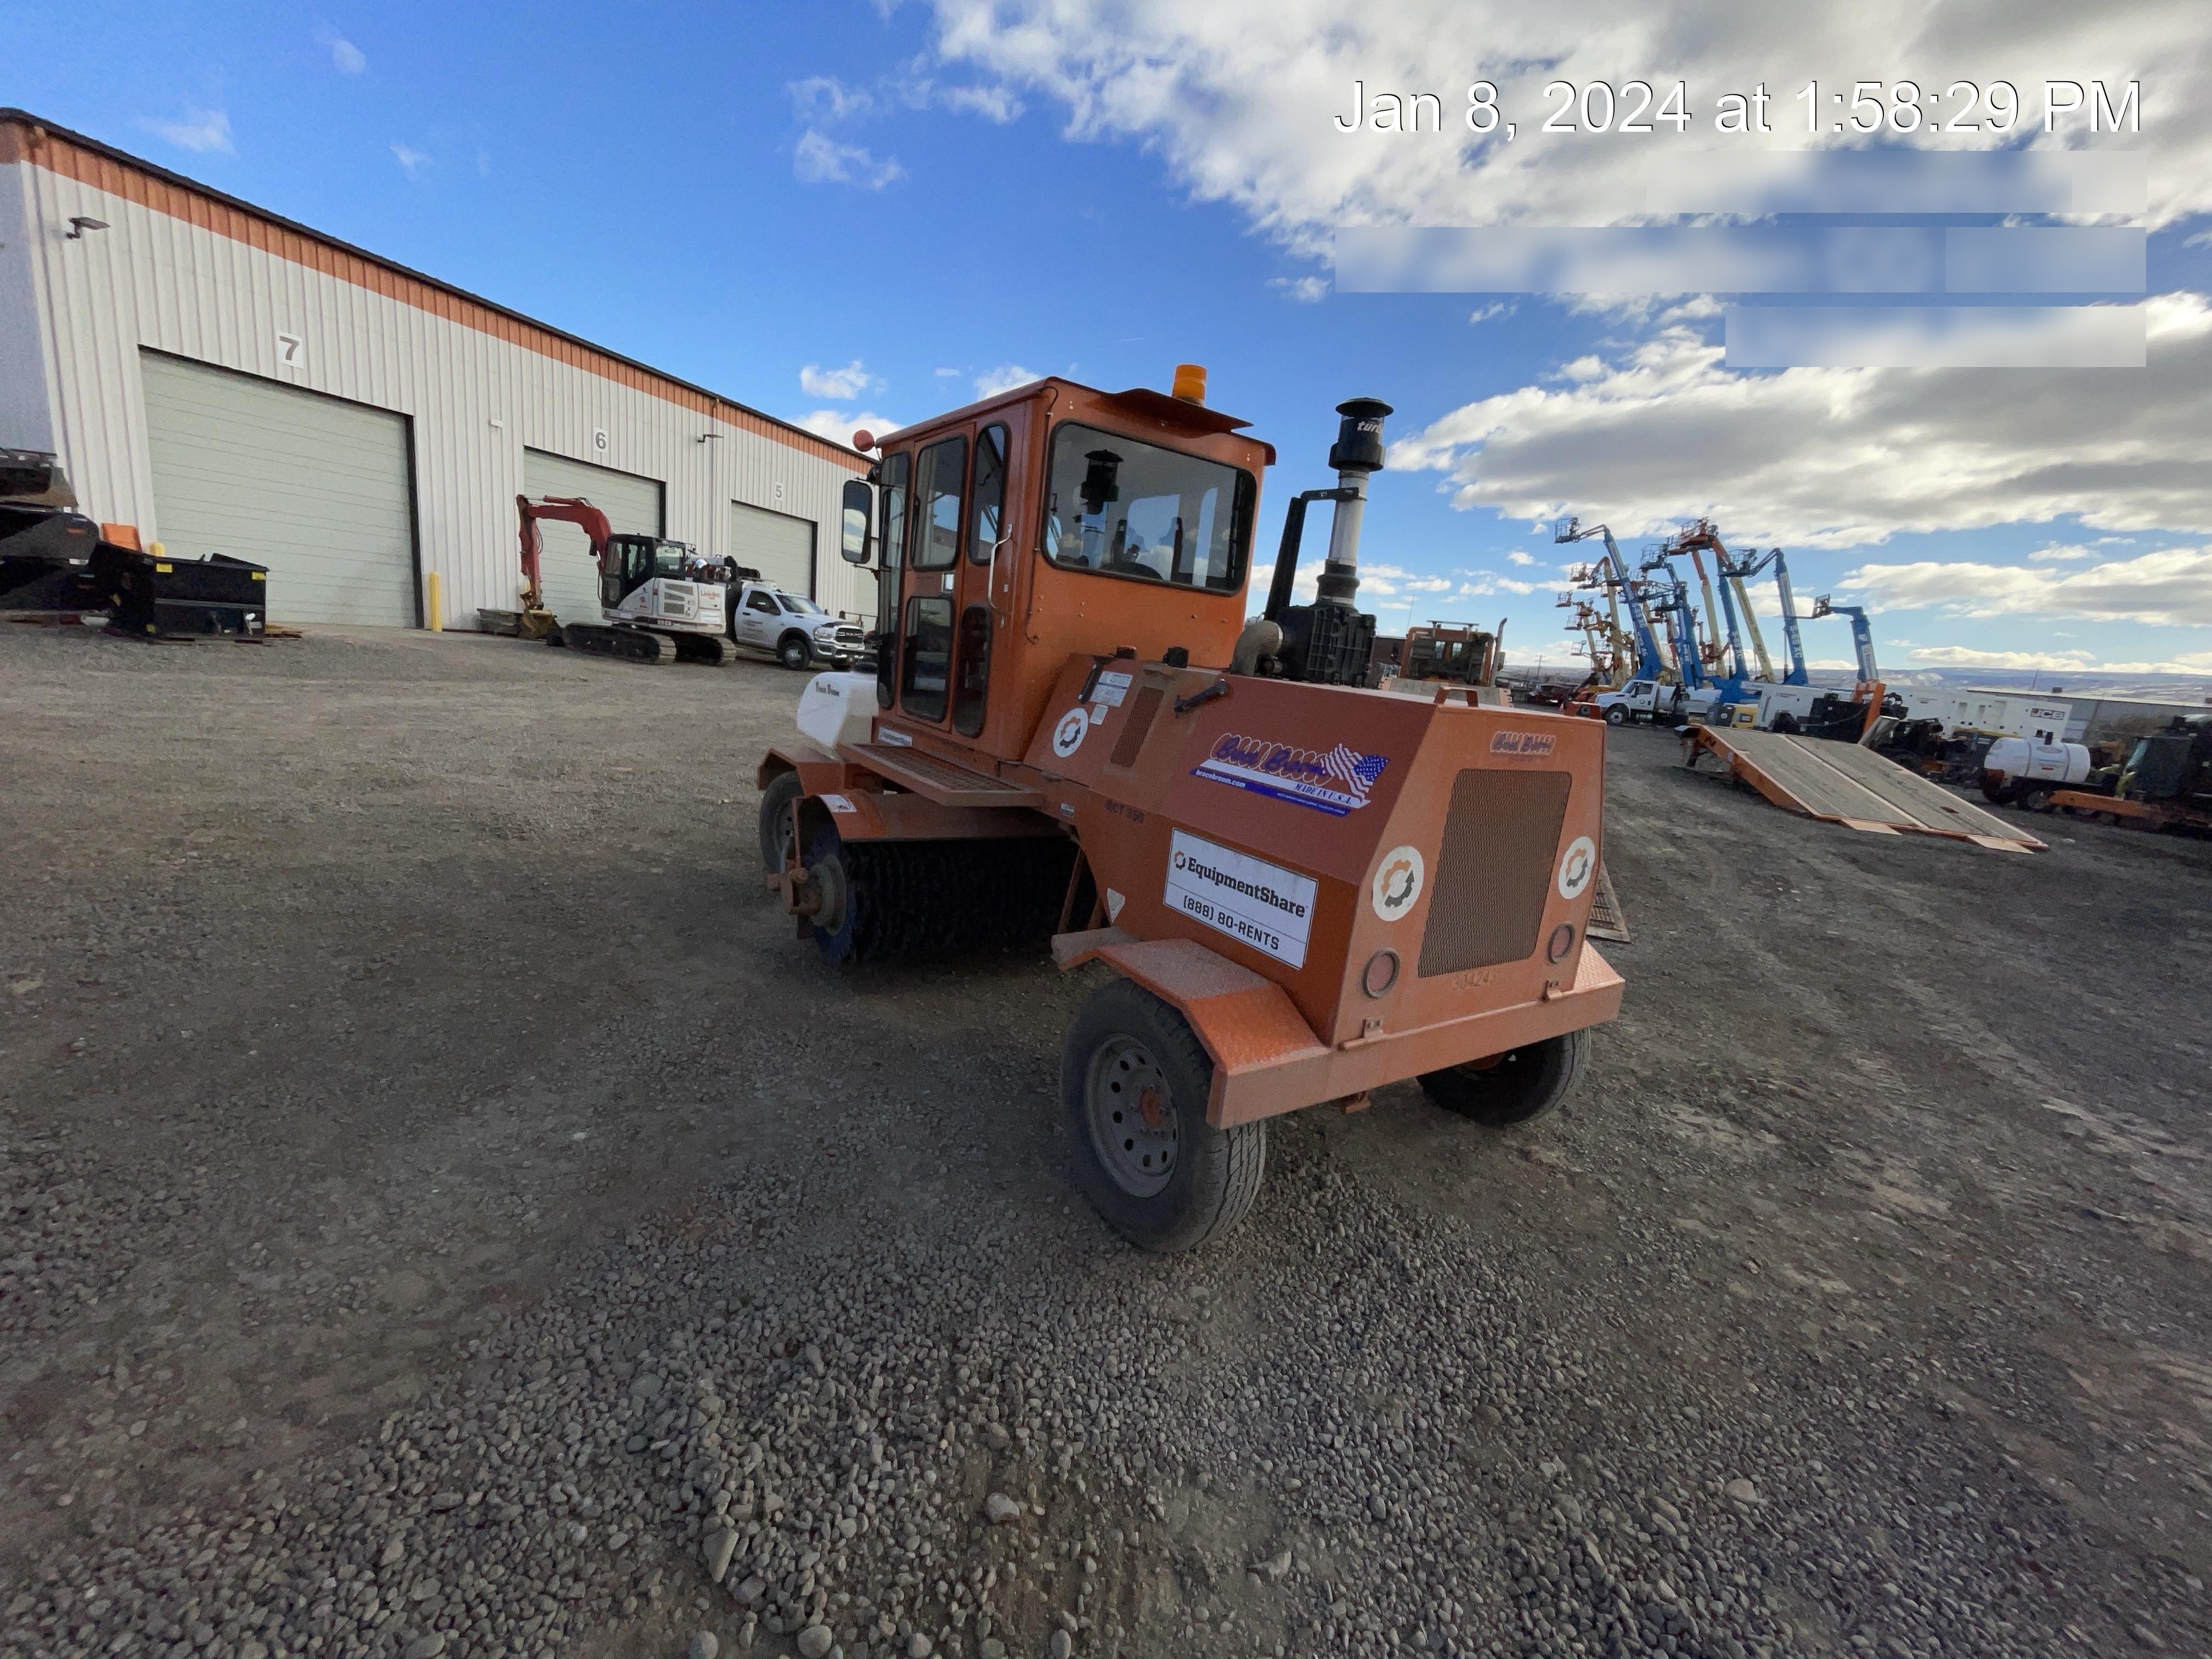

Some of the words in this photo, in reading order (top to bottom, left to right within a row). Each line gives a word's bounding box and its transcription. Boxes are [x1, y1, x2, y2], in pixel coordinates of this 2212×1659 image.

[279, 335, 300, 361] 7
[595, 432, 606, 449] 6
[775, 484, 782, 498] 5
[1187, 856, 1305, 918] EquipmentShare
[1183, 895, 1214, 921] (888)
[1217, 911, 1280, 951] 80-RENTS
